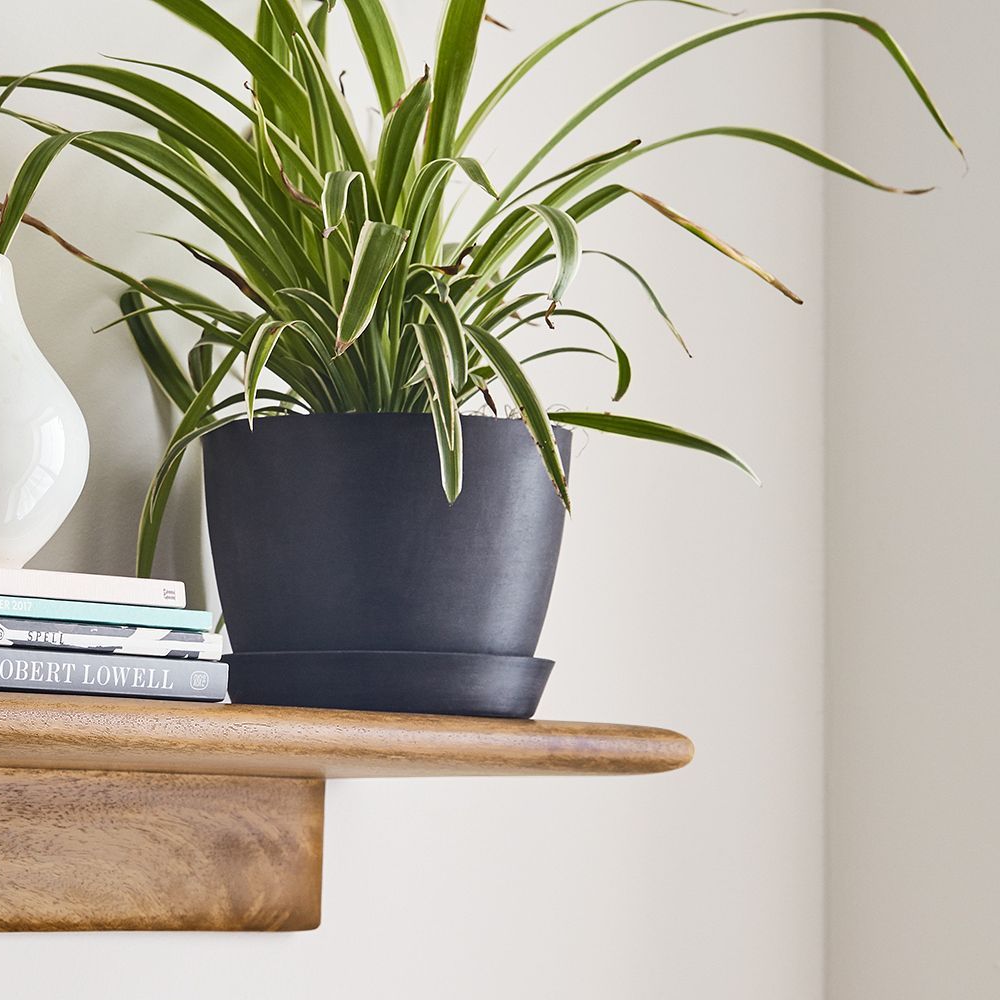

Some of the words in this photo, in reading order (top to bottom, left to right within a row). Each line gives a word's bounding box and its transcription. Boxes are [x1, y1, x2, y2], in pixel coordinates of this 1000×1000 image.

[12, 601, 33, 612] 2017
[27, 631, 65, 645] SPELL
[82, 663, 174, 690] LOWELL
